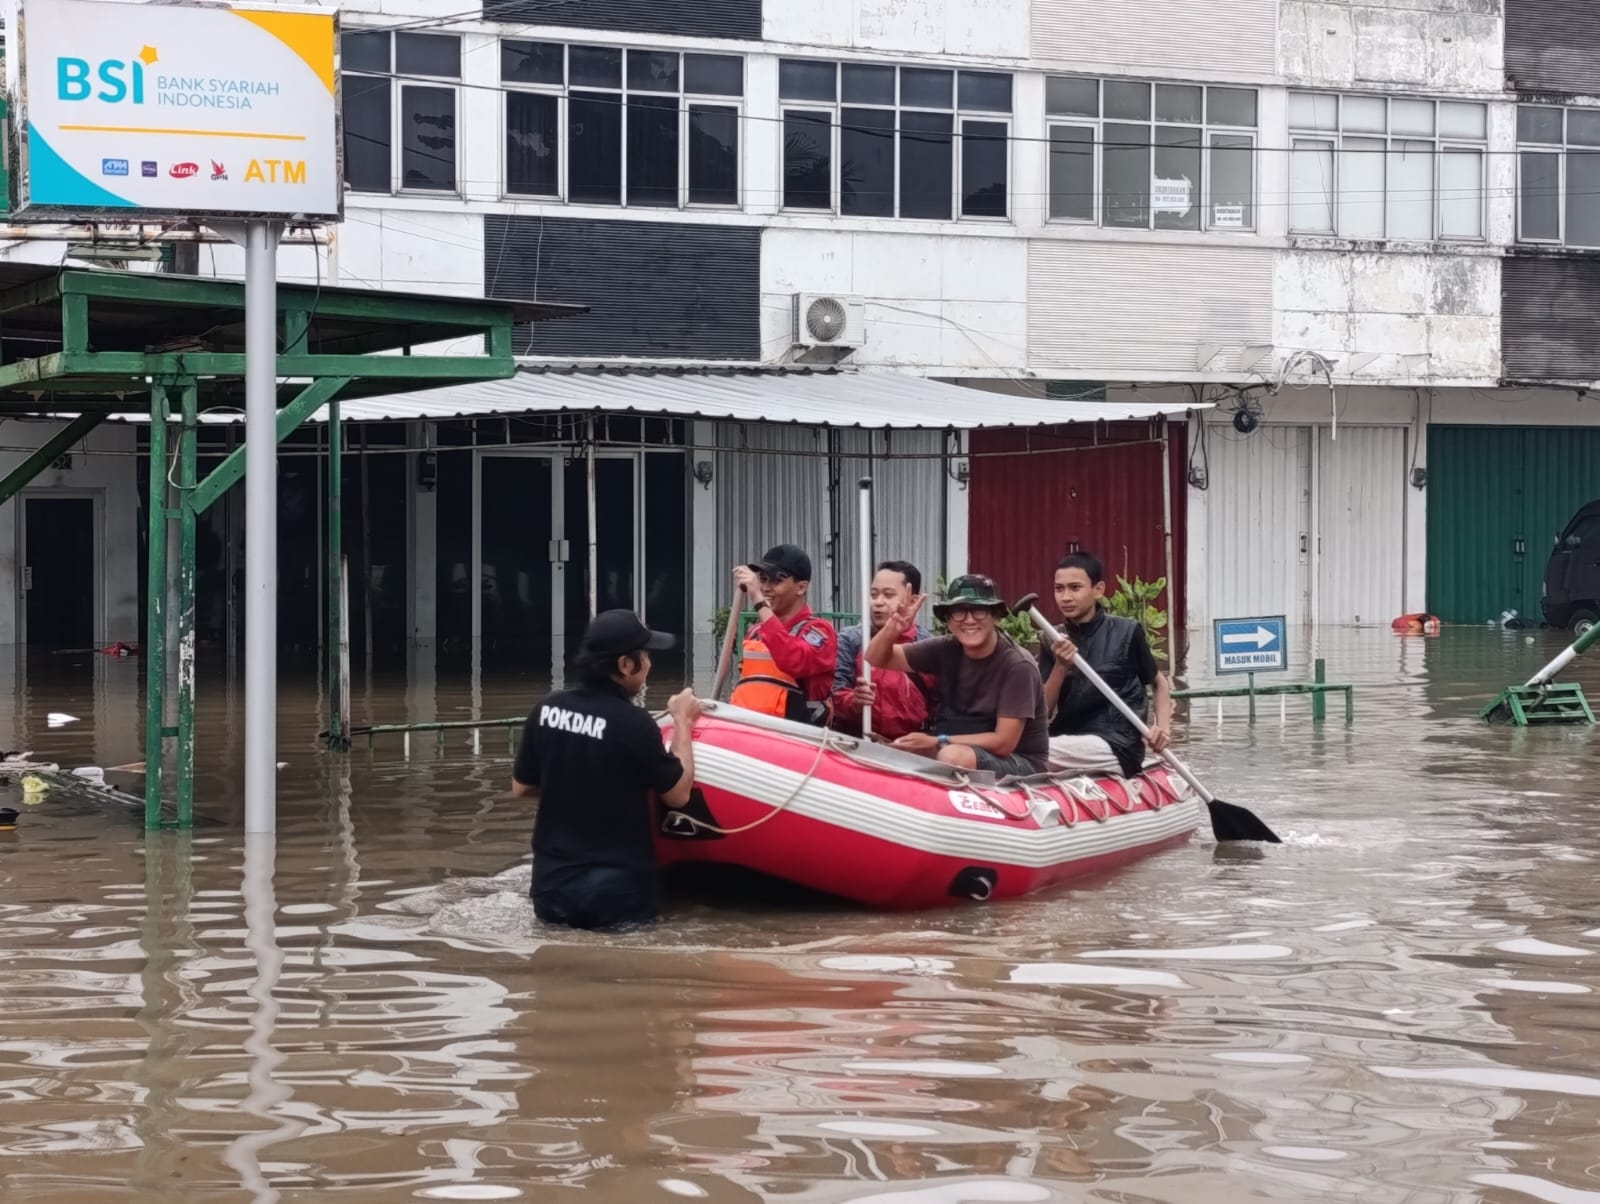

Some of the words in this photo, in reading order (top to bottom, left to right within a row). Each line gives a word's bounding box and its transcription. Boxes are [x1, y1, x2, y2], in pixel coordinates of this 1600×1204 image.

[57, 56, 145, 104] BSI
[157, 76, 205, 91] BANK
[208, 79, 280, 95] SYARIAH
[157, 92, 253, 109] INDONESIA
[244, 158, 306, 184] ATM
[1224, 655, 1252, 664] MASUK
[1253, 654, 1277, 663] MOBIL
[539, 705, 607, 740] POKDAR
